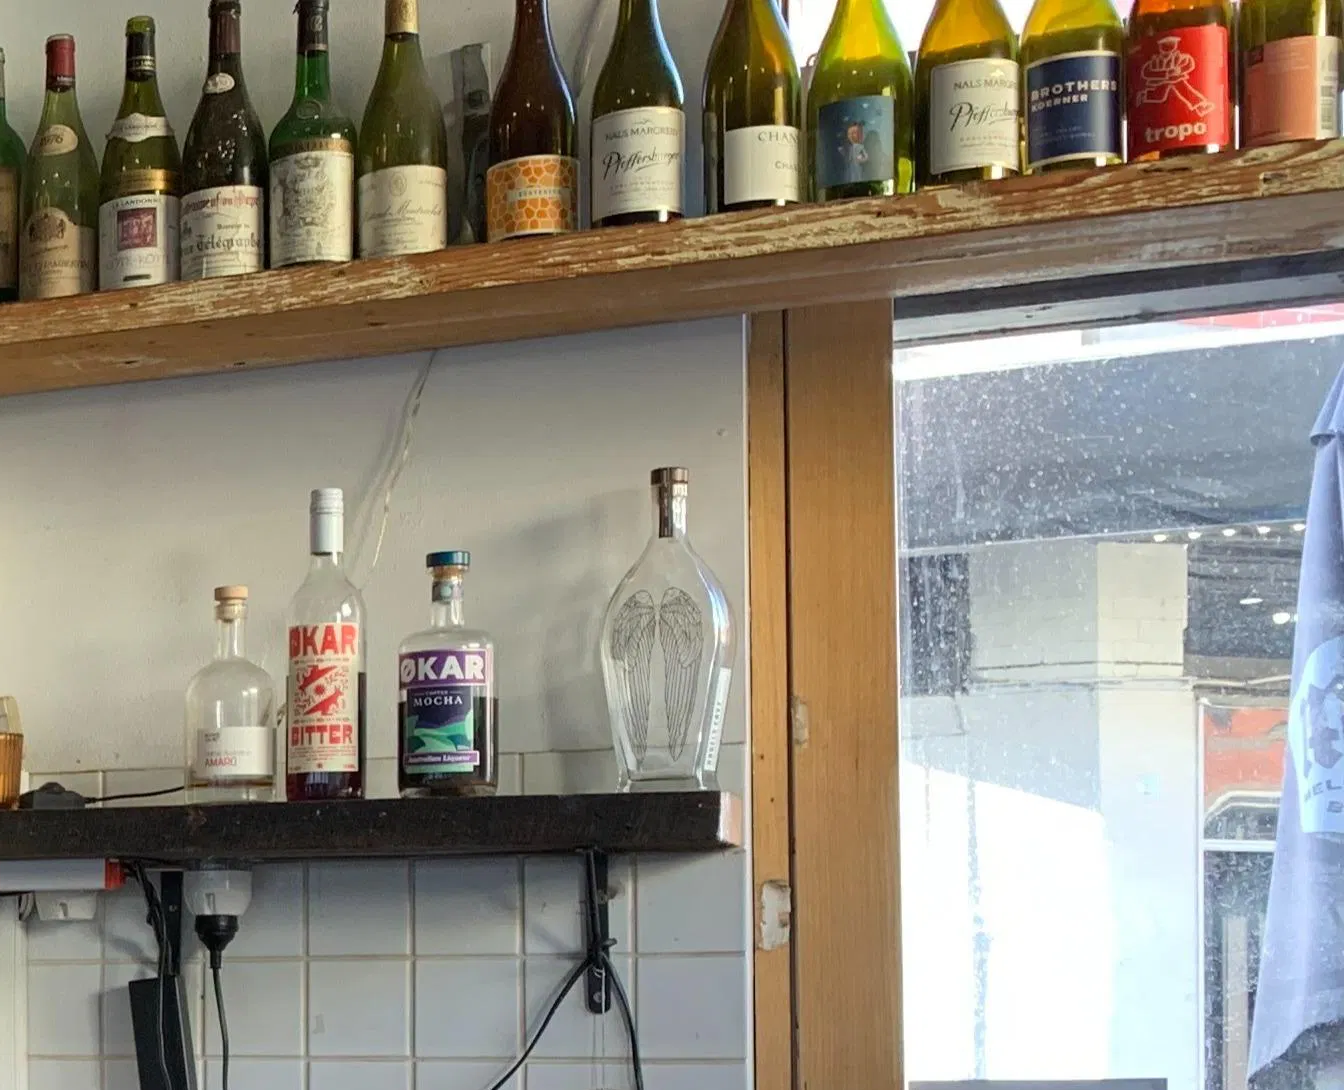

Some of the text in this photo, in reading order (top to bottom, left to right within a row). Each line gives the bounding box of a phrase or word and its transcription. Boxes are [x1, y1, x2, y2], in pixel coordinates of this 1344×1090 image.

[1031, 80, 1117, 101] BROTHERS
[1031, 94, 1088, 112] KOERNER
[1145, 122, 1207, 142] tropo
[413, 695, 463, 707] MOCHA
[290, 724, 354, 747] BITTER
